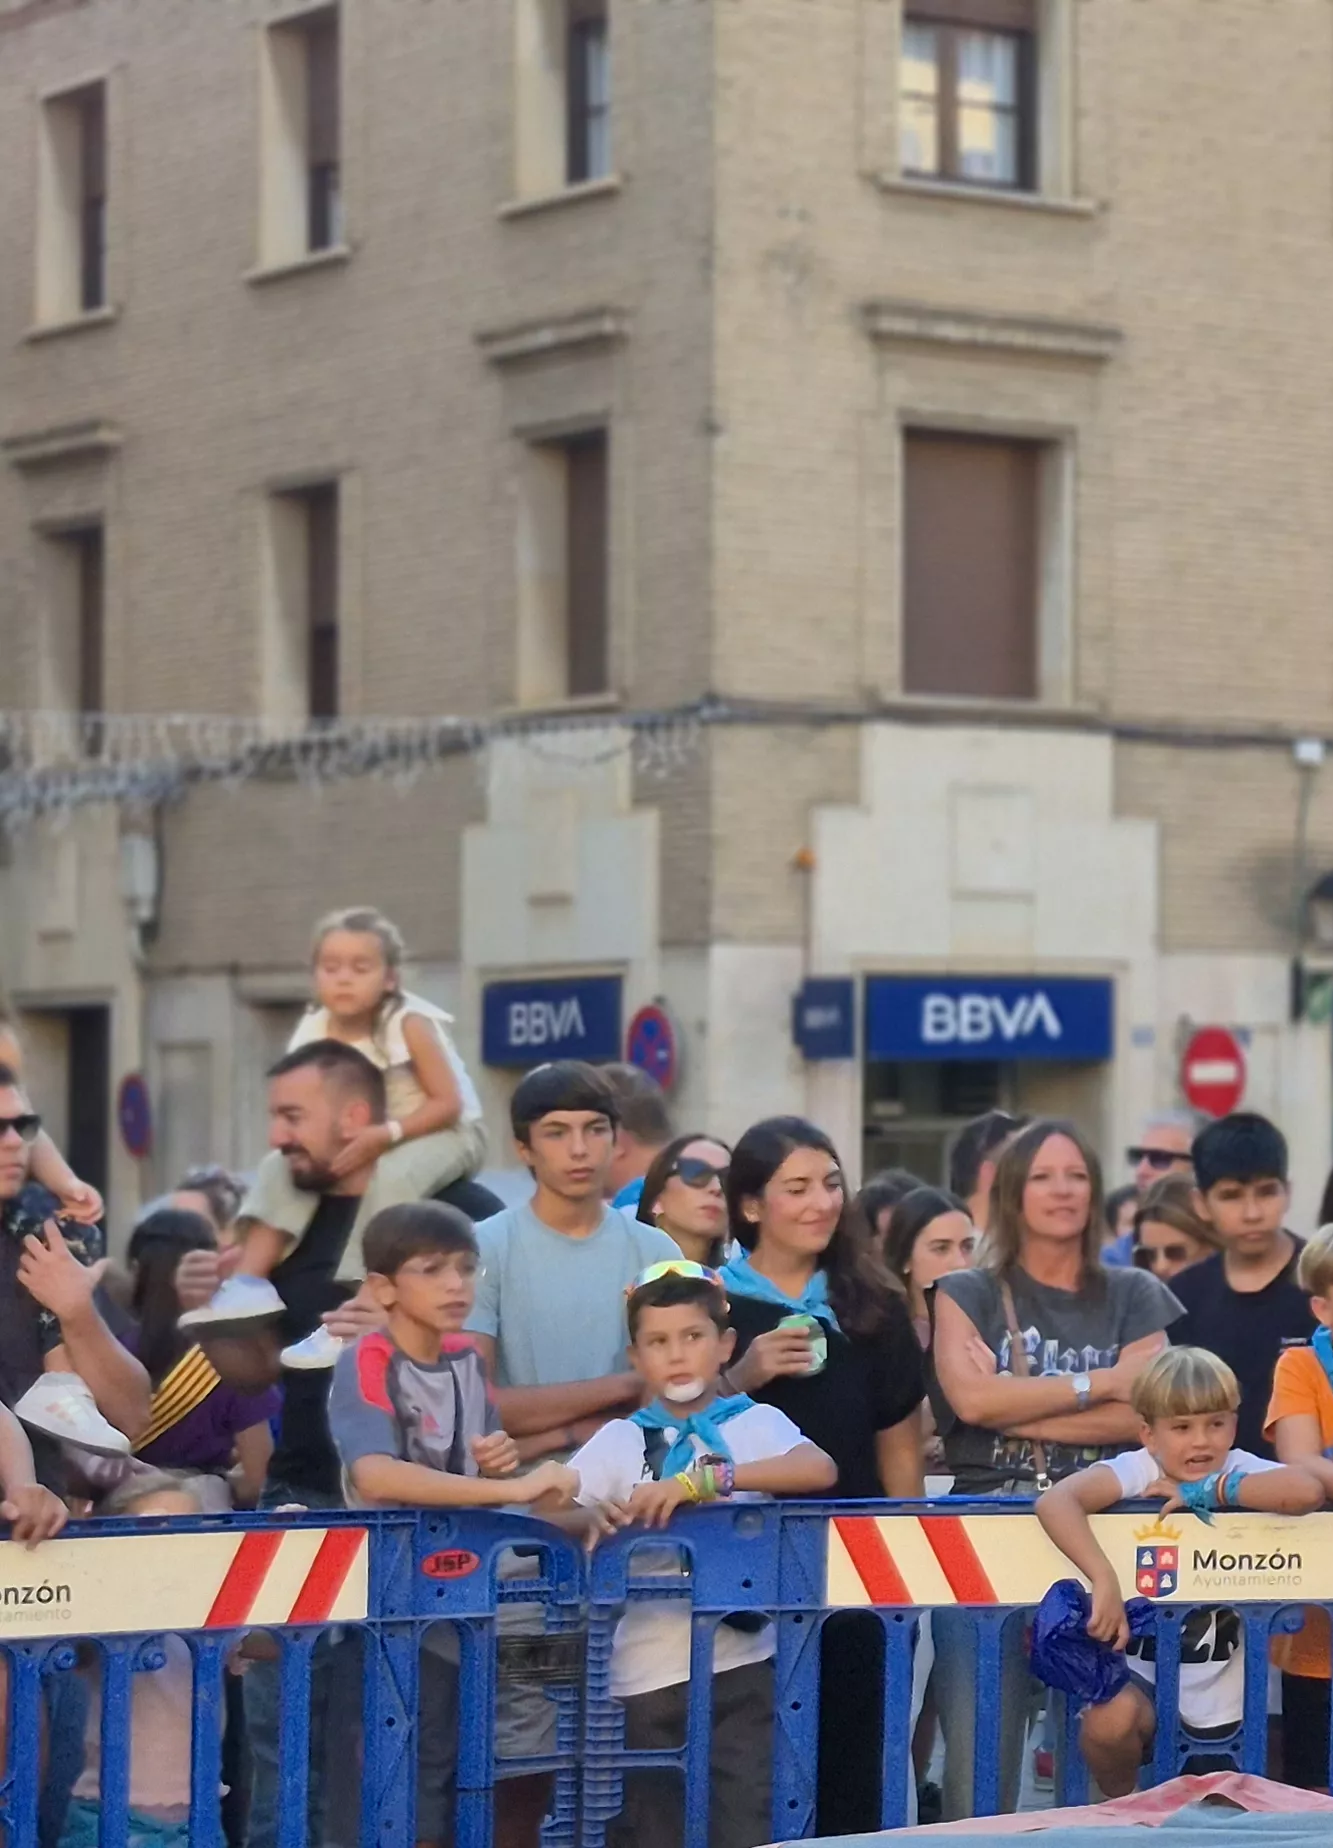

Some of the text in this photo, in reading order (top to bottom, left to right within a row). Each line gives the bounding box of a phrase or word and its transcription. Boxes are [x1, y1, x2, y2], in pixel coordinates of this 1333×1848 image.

[508, 996, 586, 1046] BBVA
[921, 991, 1062, 1041] BBVA
[1193, 1547, 1302, 1571] Monzón
[0, 1579, 71, 1605] nzón
[1193, 1574, 1302, 1589] Ayuntamiento
[0, 1608, 72, 1622] amiento
